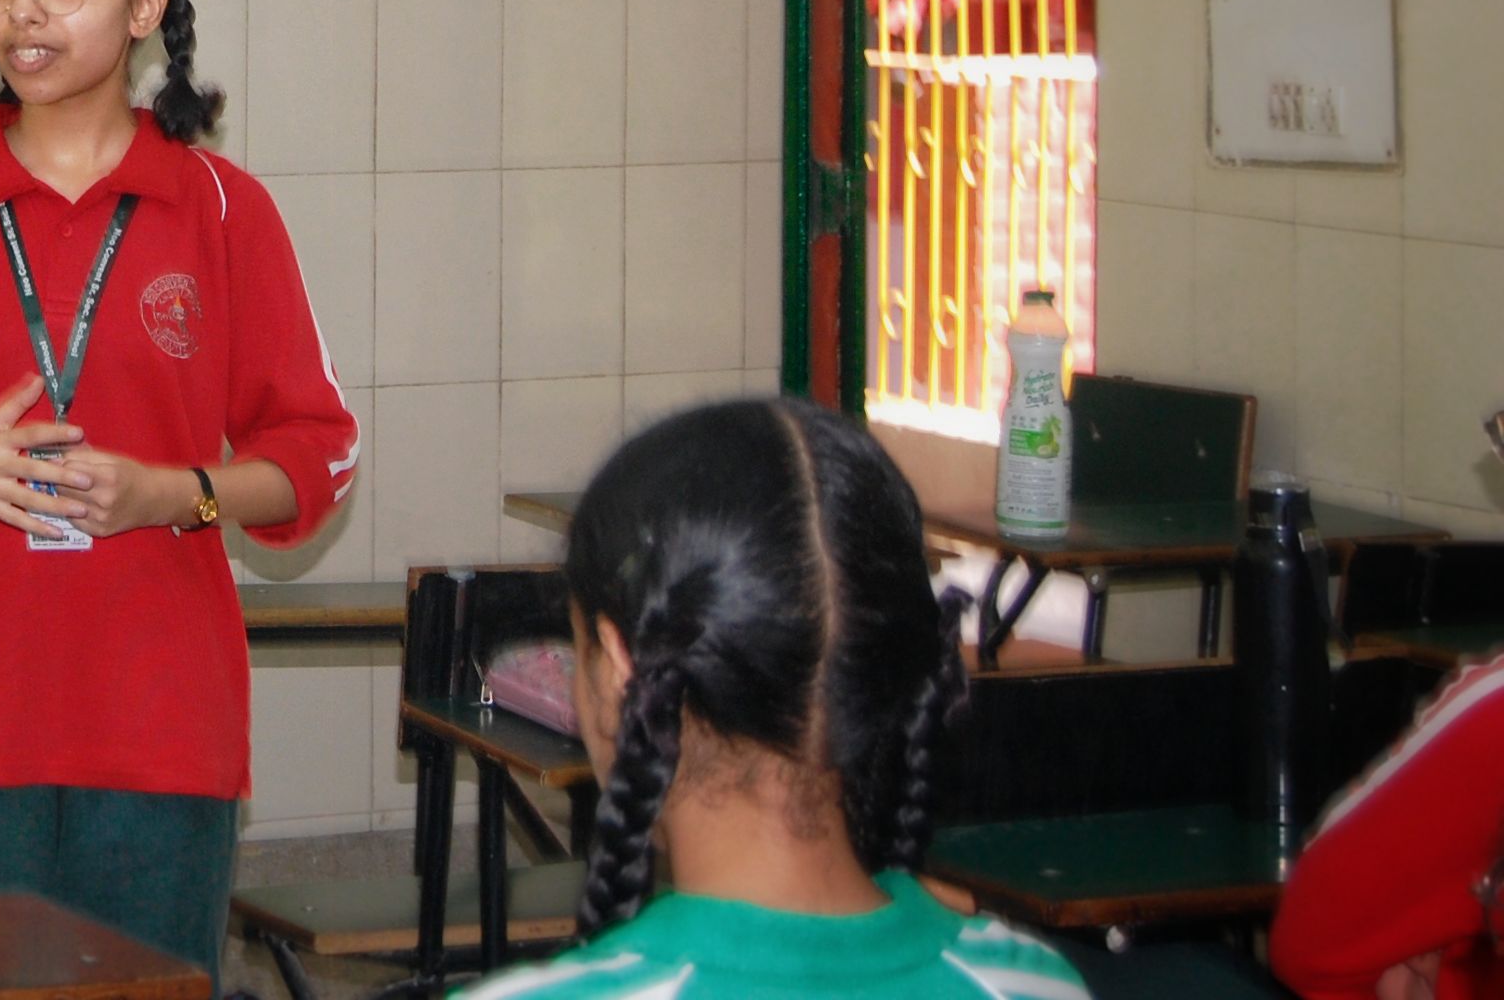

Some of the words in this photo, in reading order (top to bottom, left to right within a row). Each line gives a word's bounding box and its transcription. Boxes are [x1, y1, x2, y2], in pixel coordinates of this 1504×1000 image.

[10, 239, 27, 276] Convent
[95, 247, 115, 281] Convent
[71, 321, 88, 358] School
[39, 340, 55, 377] School
